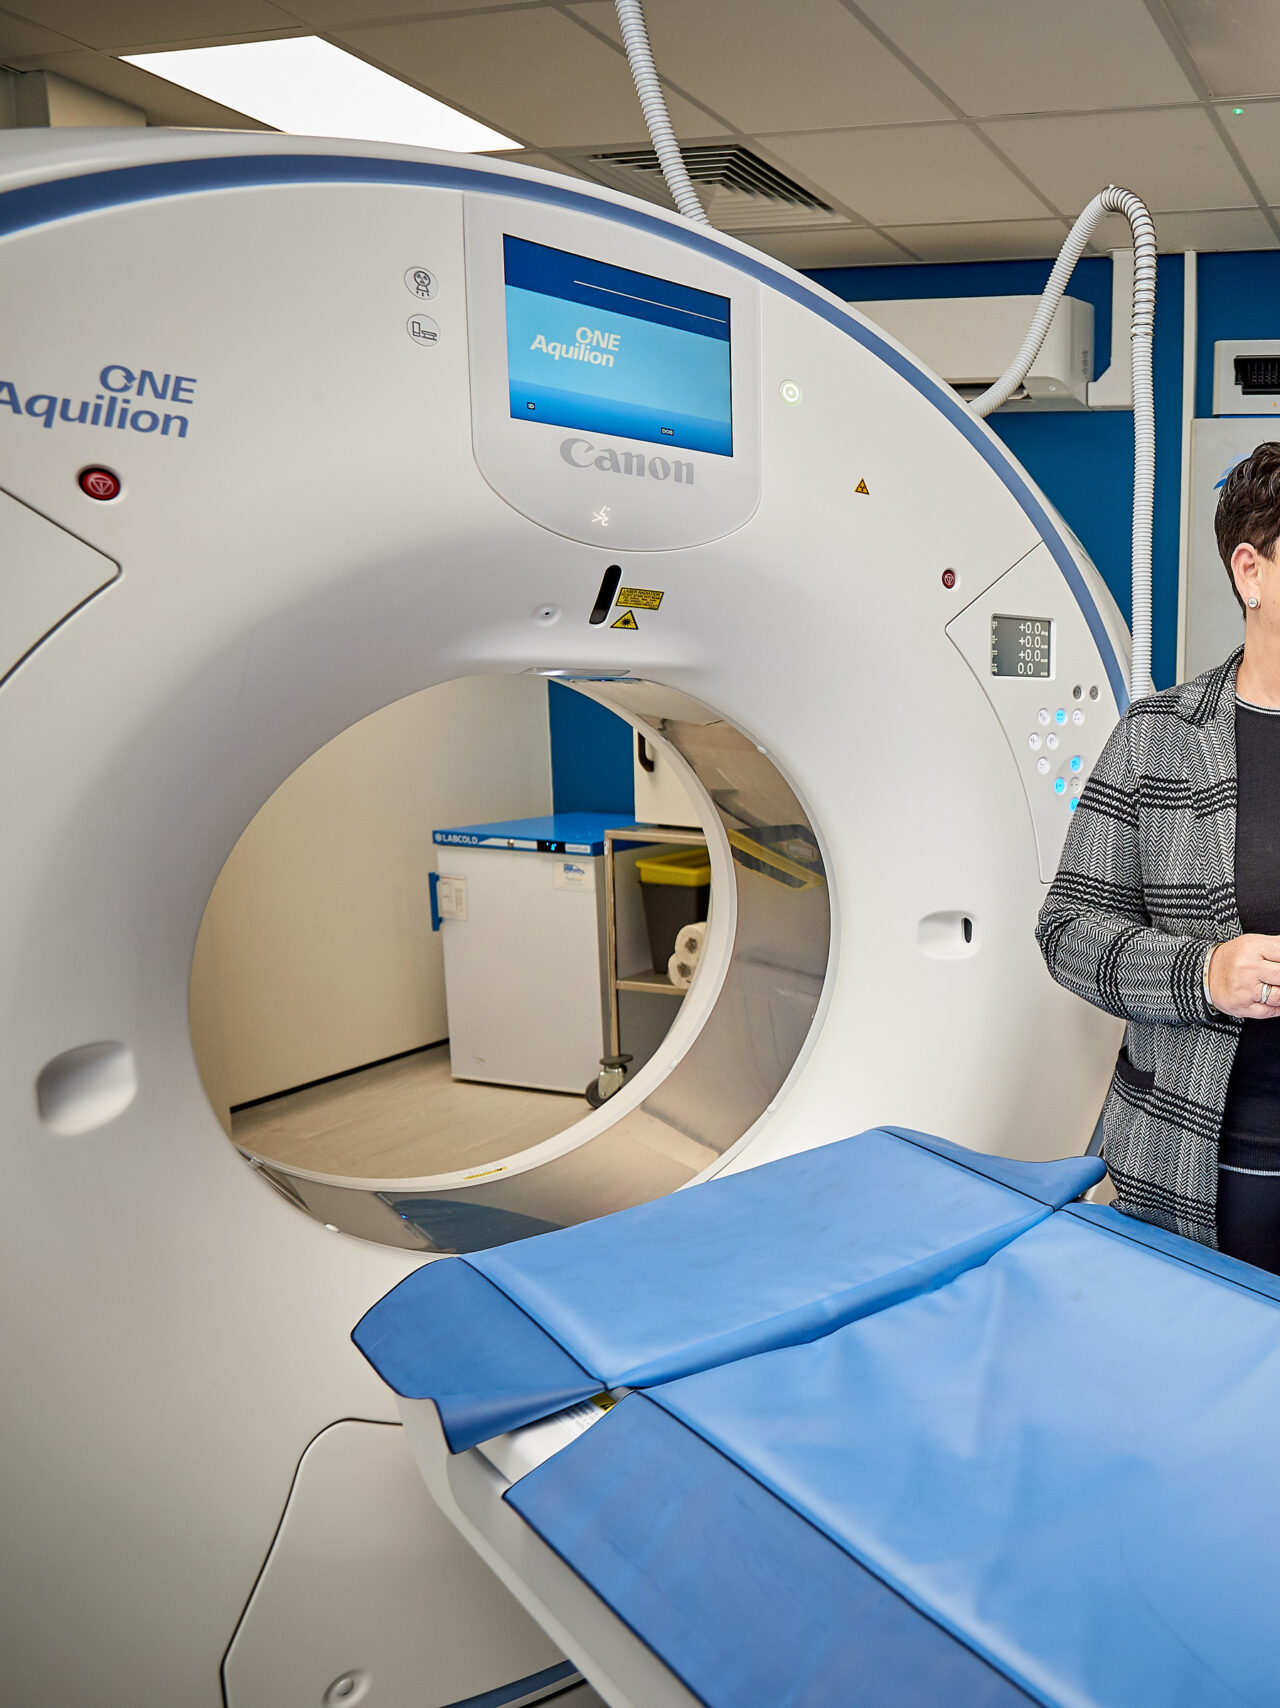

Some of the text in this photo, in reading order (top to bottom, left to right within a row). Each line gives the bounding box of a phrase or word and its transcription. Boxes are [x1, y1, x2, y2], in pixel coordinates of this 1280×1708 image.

[575, 326, 622, 351] ONE
[529, 334, 615, 368] Aquilion
[99, 364, 198, 404] ONE
[0, 379, 190, 438] Aquilion
[559, 437, 695, 485] Canon
[1018, 621, 1041, 635] +0.0
[1018, 635, 1041, 648] +0.0
[1018, 649, 1041, 662] +0.0
[1017, 662, 1034, 675] 0.0
[442, 832, 479, 844] LABCOLD
